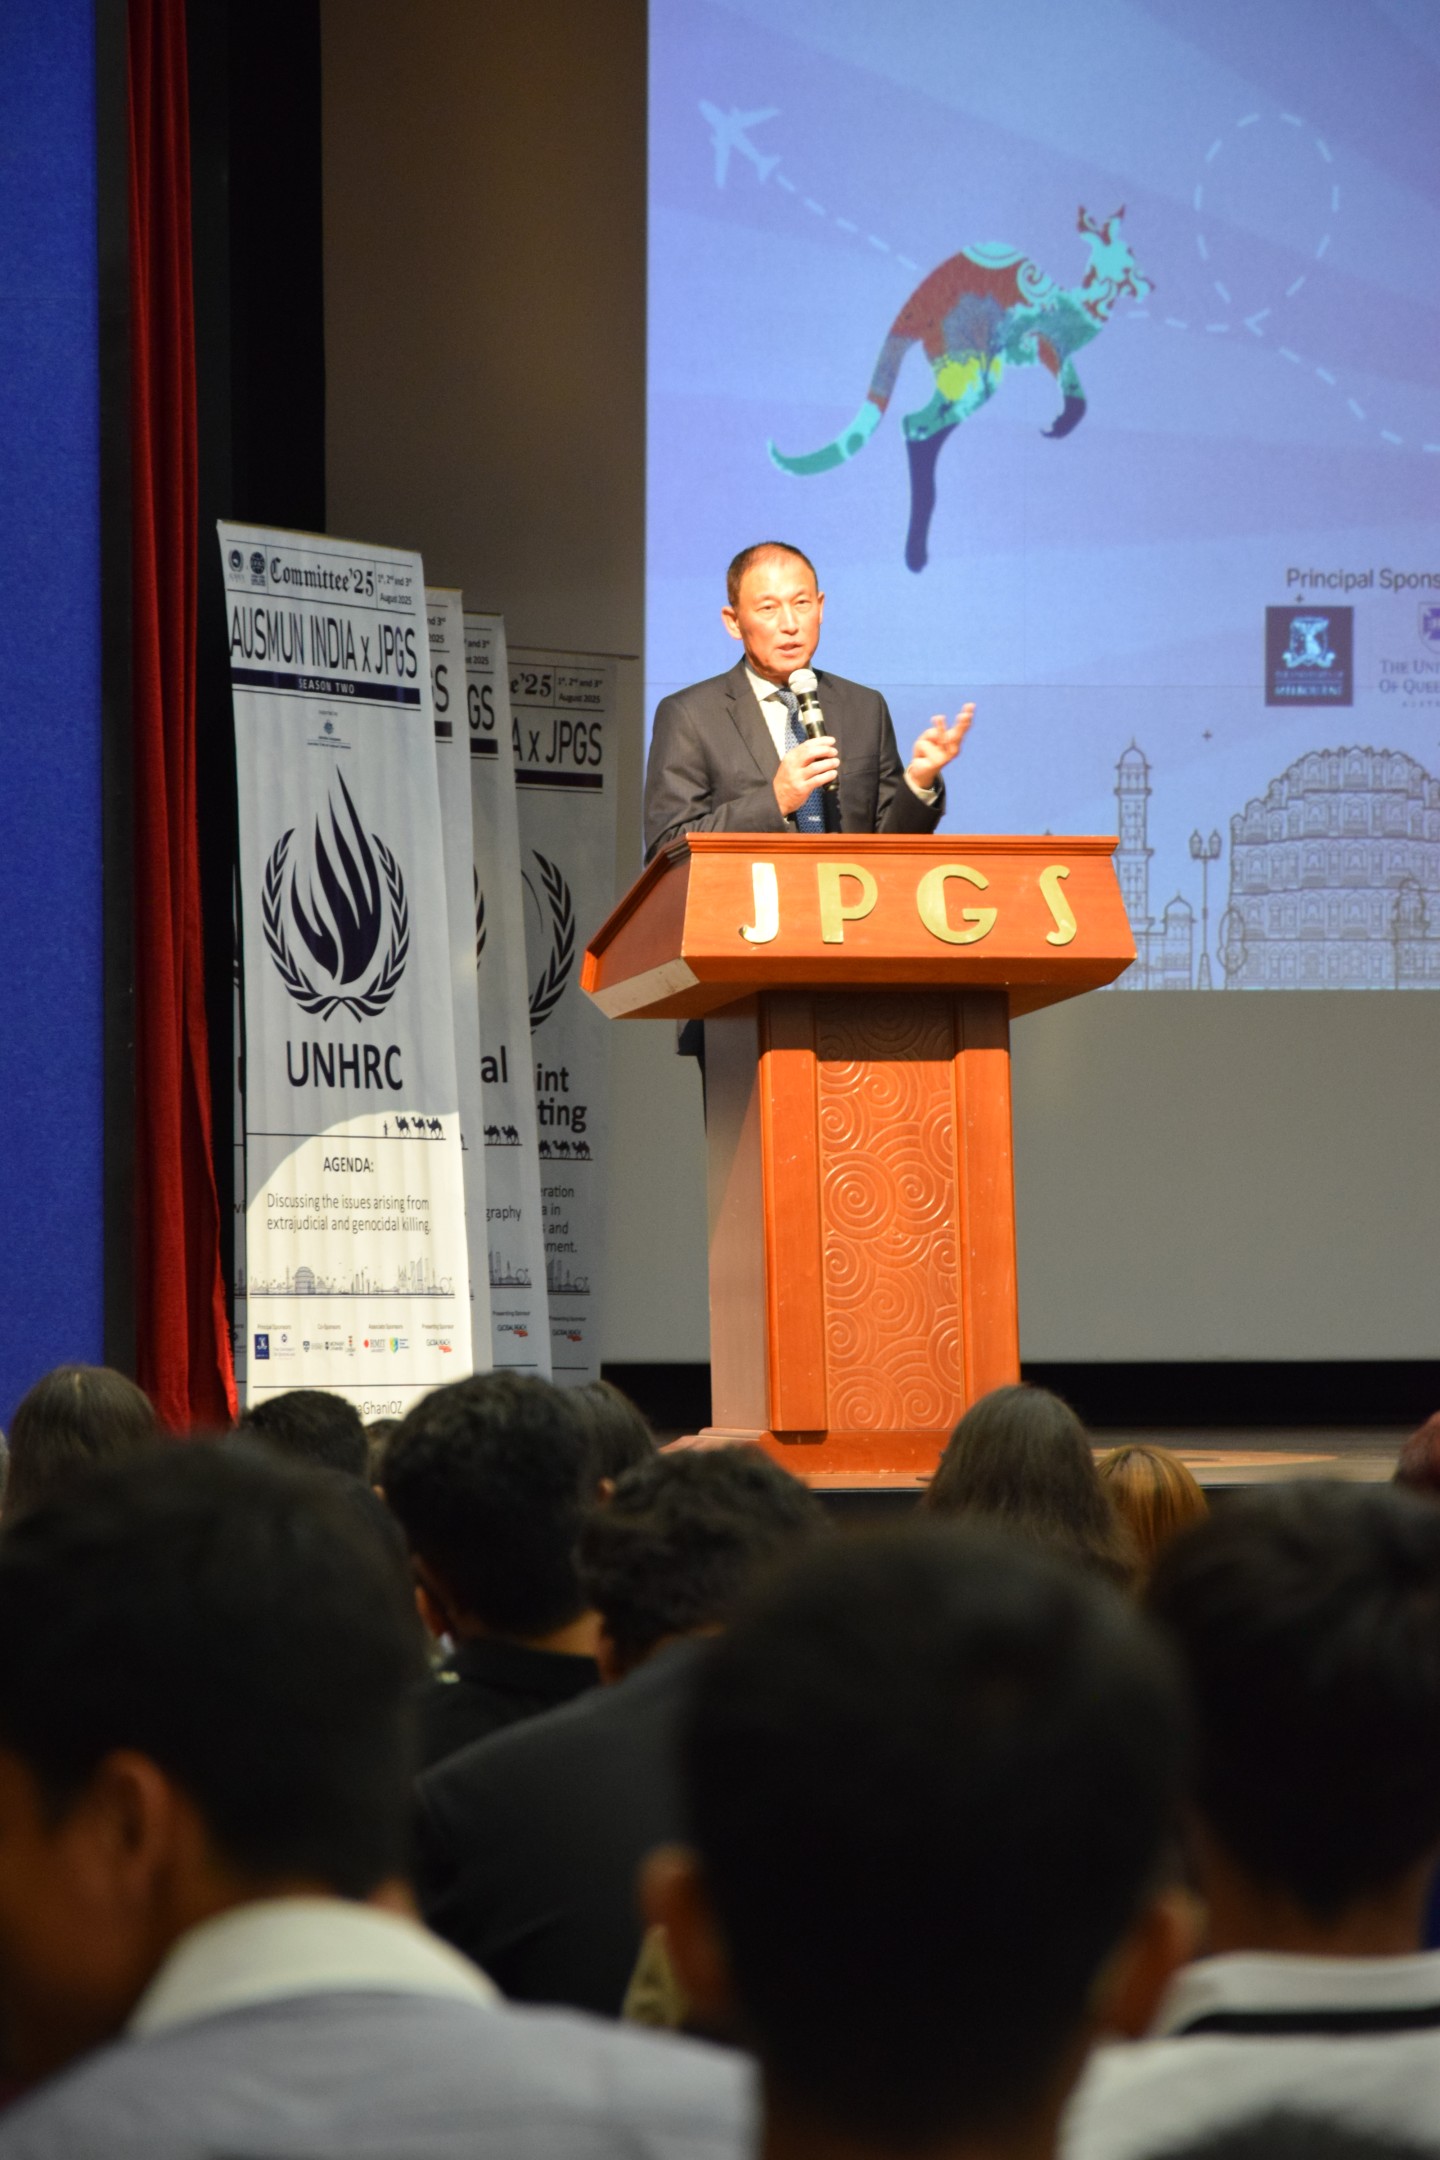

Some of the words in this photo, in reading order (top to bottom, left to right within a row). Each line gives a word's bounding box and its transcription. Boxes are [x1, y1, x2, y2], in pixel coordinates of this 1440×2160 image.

[270, 557, 375, 597] Committee'25
[1286, 568, 1374, 593] Principal
[1379, 568, 1440, 593] Spons
[230, 605, 305, 665] AUSMUN
[310, 614, 358, 672] INDIA
[375, 623, 418, 678] JPGS
[473, 655, 490, 665] 2025
[298, 678, 332, 692] SEASON
[335, 681, 355, 695] TWO
[431, 664, 450, 713] S
[467, 684, 495, 732] GS
[545, 719, 603, 767] JPGS
[286, 1040, 403, 1091] UNHRC
[480, 1045, 508, 1083] al
[536, 1063, 570, 1092] int
[537, 1096, 587, 1134] ting
[323, 1156, 374, 1173] AGENDA:
[266, 1192, 320, 1212] Discussing
[321, 1193, 339, 1209] the
[341, 1193, 371, 1210] issues
[373, 1194, 405, 1214] arising
[406, 1195, 430, 1211] from
[551, 1201, 561, 1216] in
[266, 1215, 329, 1233] extrajudicial
[331, 1216, 350, 1231] and
[352, 1216, 400, 1235] genocidal
[402, 1217, 432, 1236] killing.
[548, 1220, 569, 1235] and
